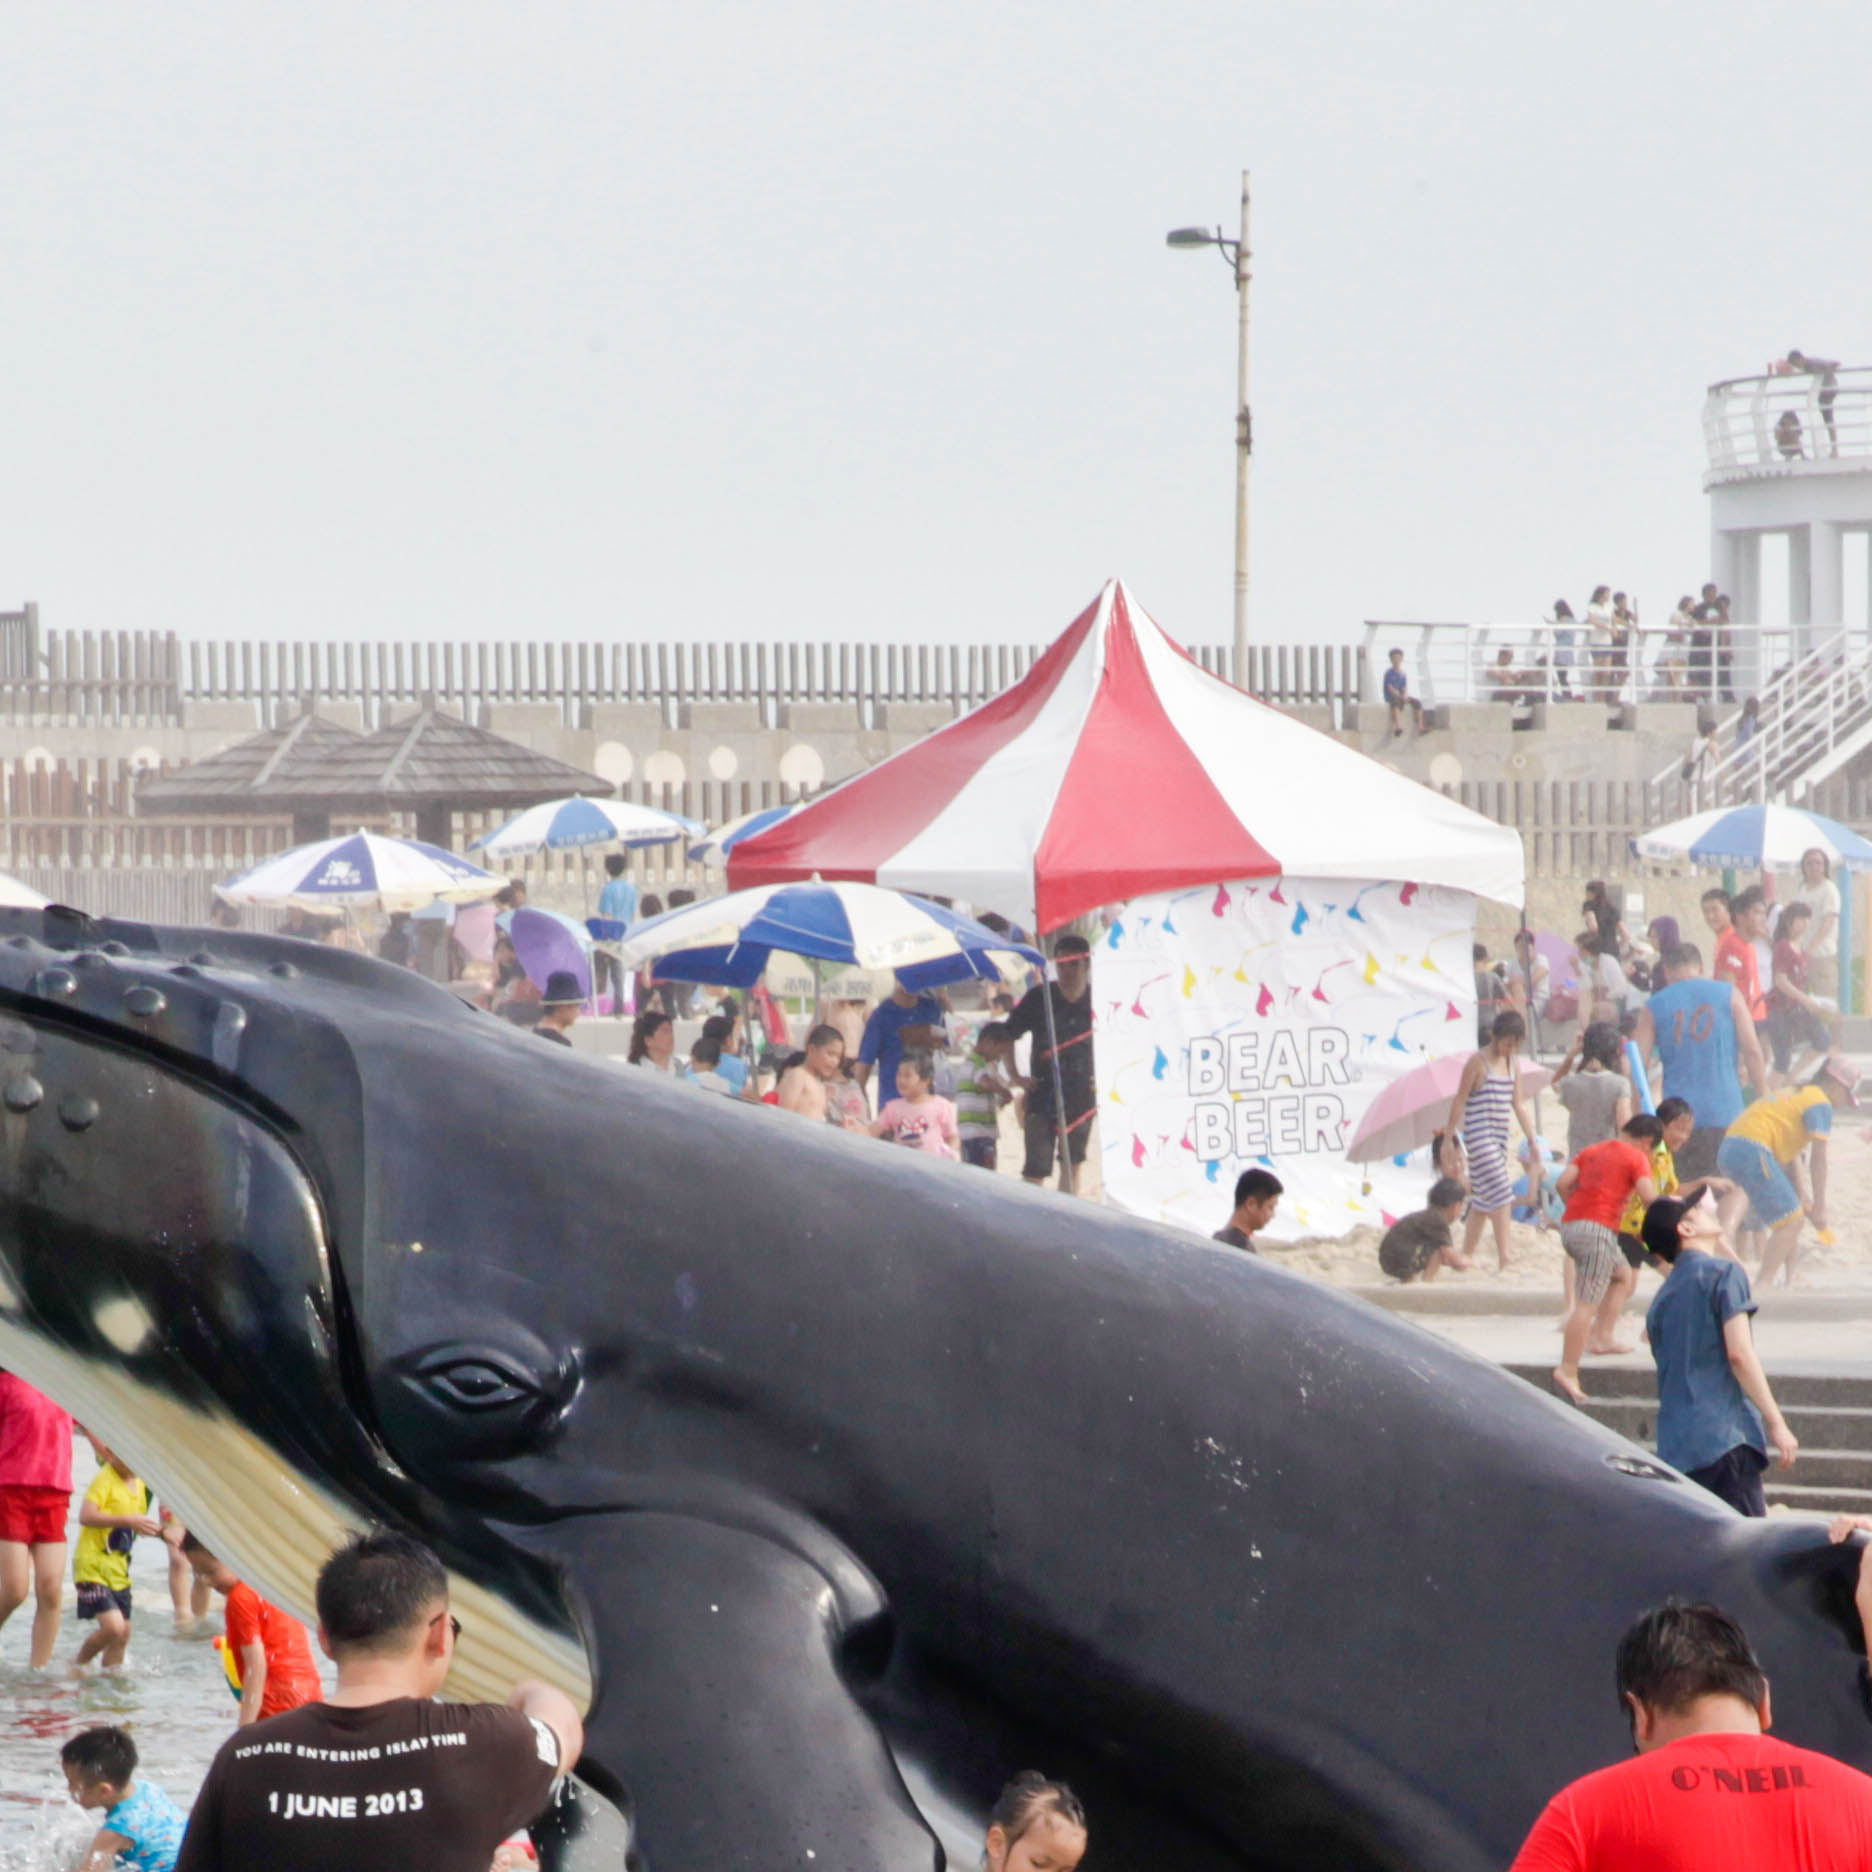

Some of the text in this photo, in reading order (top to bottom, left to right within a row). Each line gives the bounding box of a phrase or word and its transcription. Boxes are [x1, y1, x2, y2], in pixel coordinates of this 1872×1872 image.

[1673, 1003, 1714, 1044] 10
[1188, 1026, 1351, 1097] BEAR
[1194, 1093, 1345, 1163] BEER
[236, 1732, 467, 1762] YOU ARE ENTERING ISLAY TIME
[268, 1788, 424, 1820] 1 JUNE 2013
